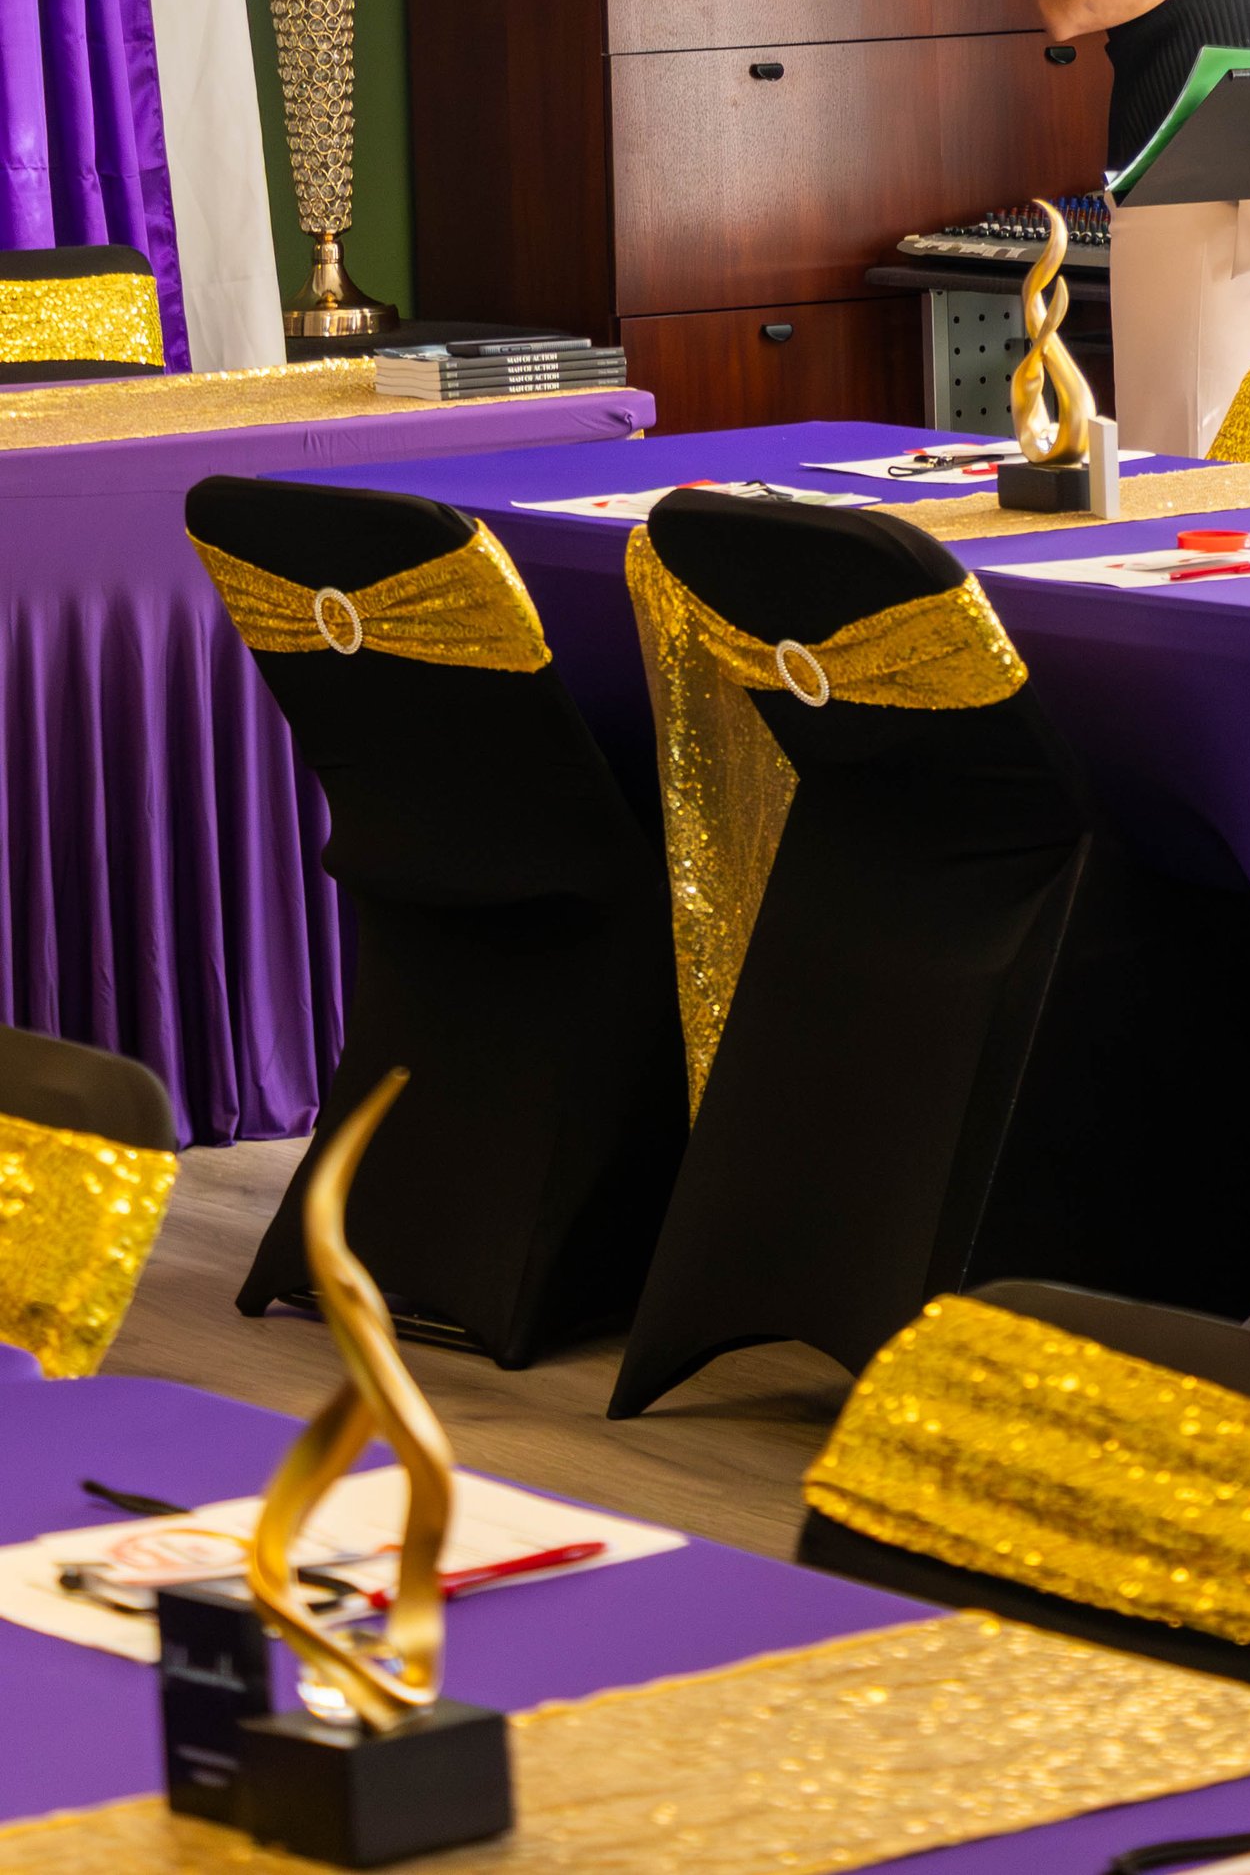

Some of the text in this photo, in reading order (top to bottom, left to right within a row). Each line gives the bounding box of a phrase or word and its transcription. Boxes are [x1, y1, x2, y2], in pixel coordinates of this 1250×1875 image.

[533, 353, 557, 361] ACTION
[534, 363, 559, 371] ACTION
[535, 372, 560, 381] ACTION
[535, 382, 560, 391] ACTION
